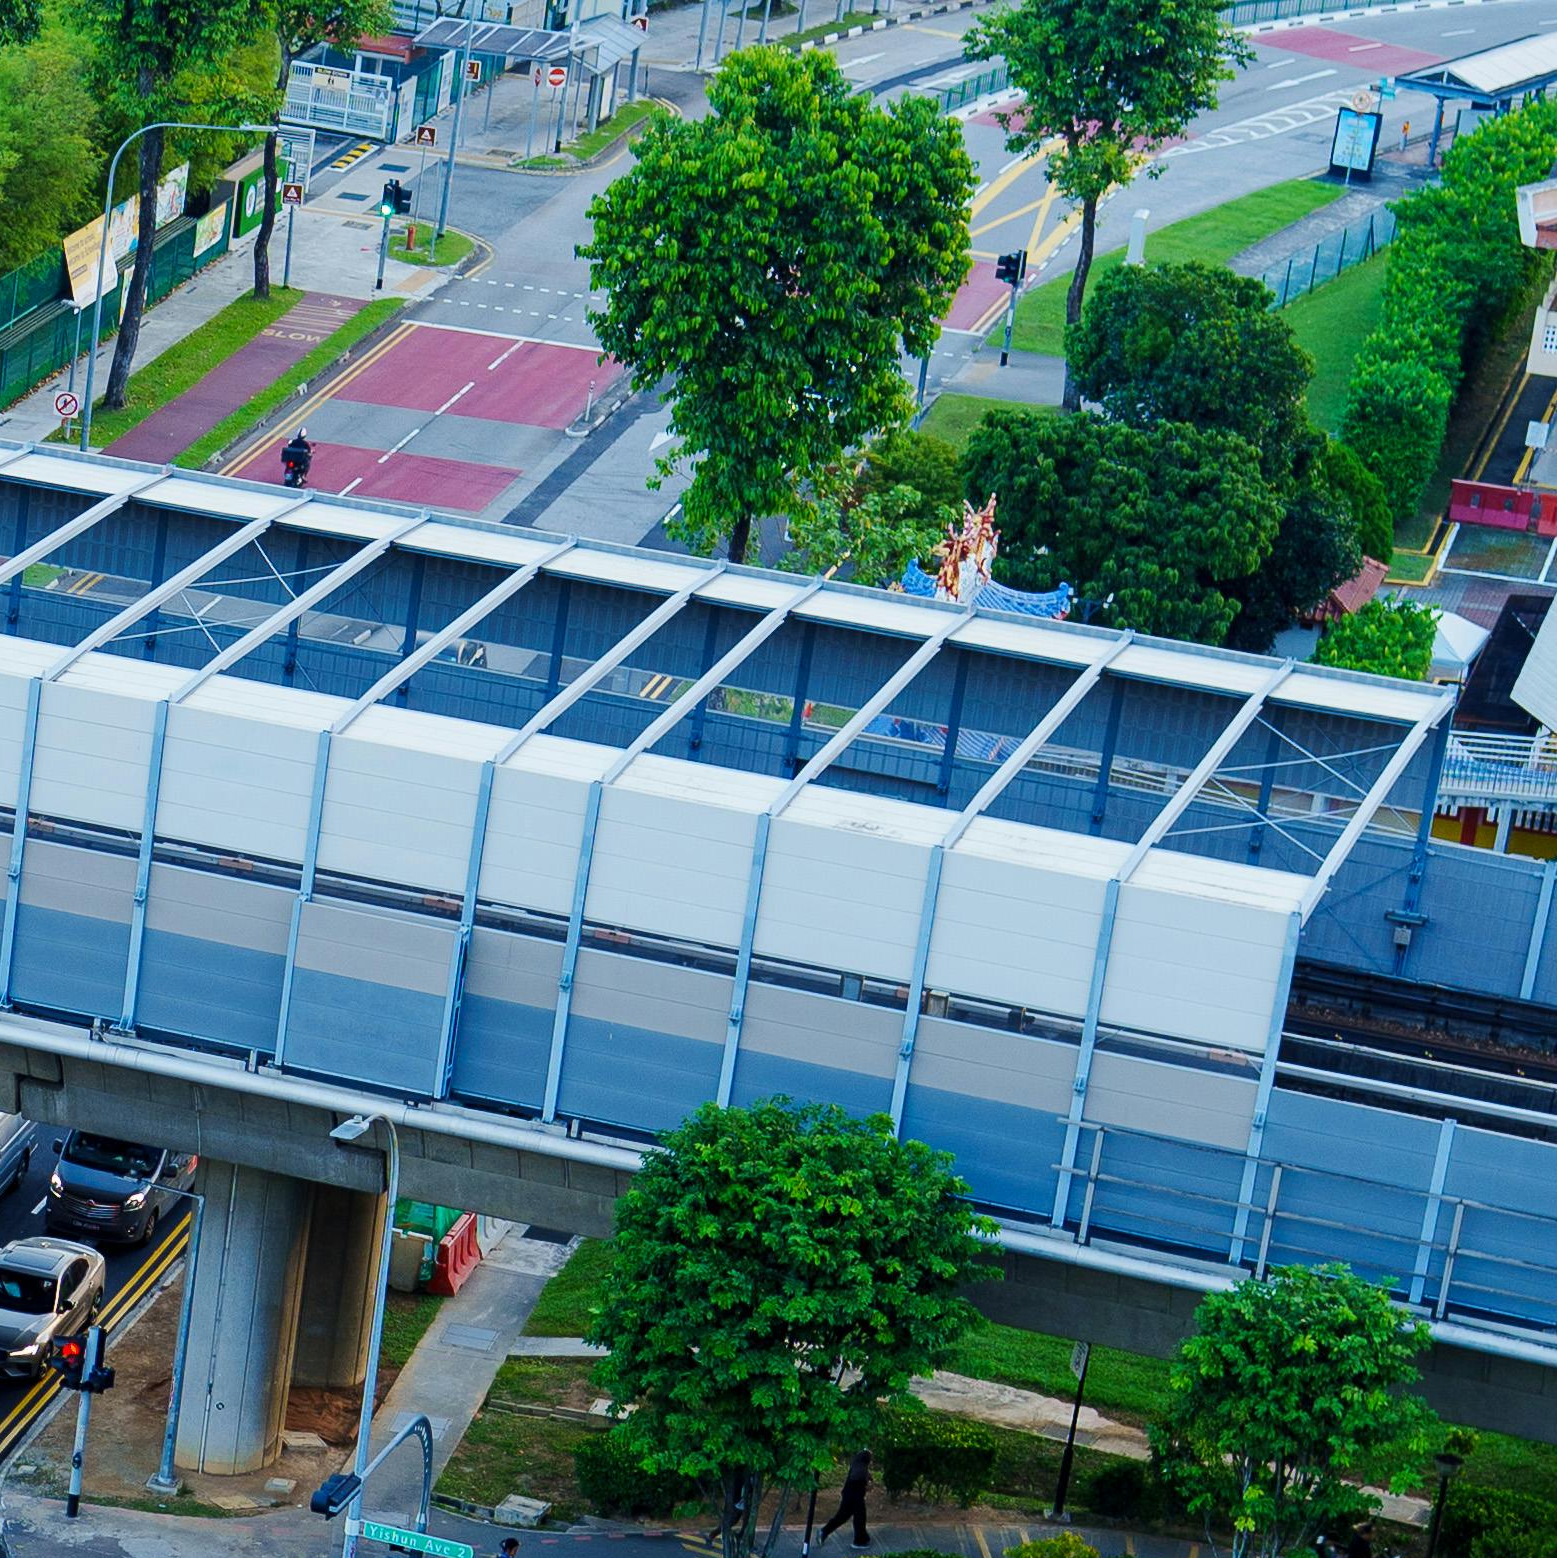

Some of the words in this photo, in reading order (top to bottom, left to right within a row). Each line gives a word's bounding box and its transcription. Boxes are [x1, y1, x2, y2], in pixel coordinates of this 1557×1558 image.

[261, 328, 321, 343] SLOW
[369, 1525, 417, 1547] Yishun
[425, 1539, 450, 1555] Ave
[457, 1547, 466, 1558] 2
